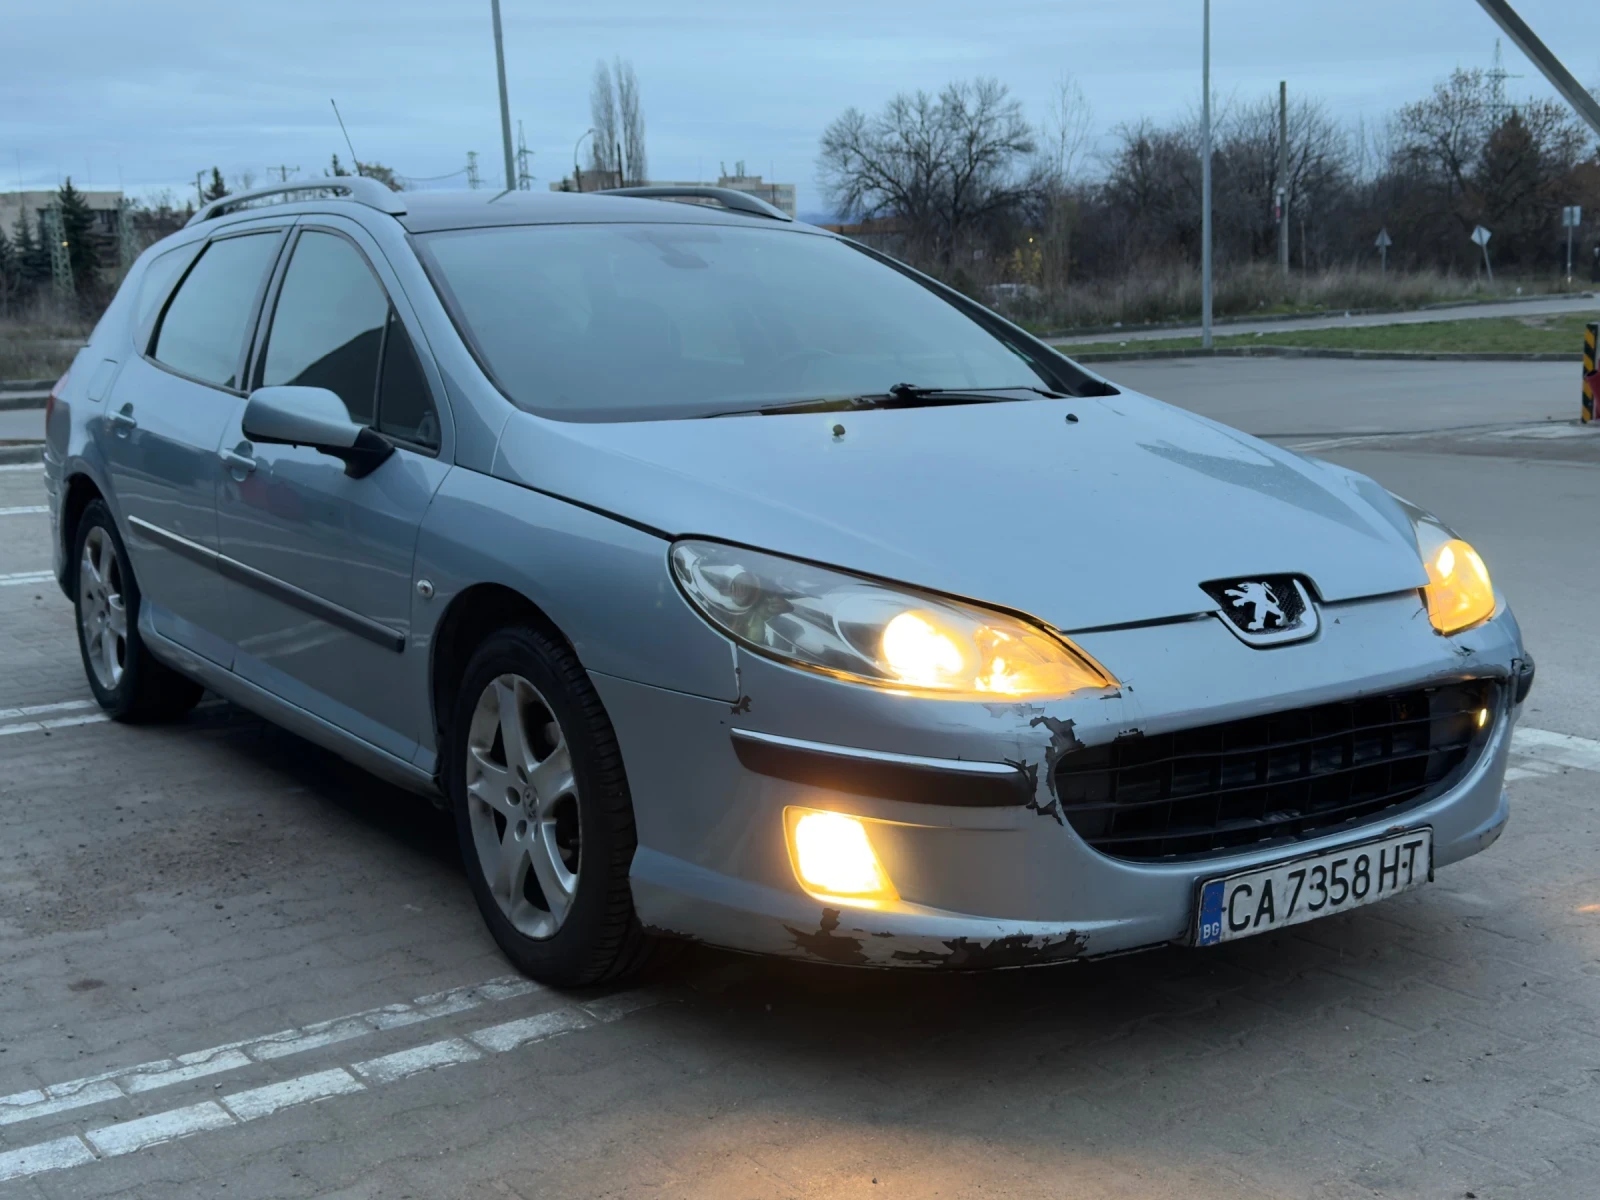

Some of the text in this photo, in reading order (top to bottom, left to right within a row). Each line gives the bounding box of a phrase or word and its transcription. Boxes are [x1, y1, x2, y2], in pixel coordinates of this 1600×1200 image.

[1228, 840, 1423, 932] CA 7358 HT
[1203, 922, 1220, 939] BG
